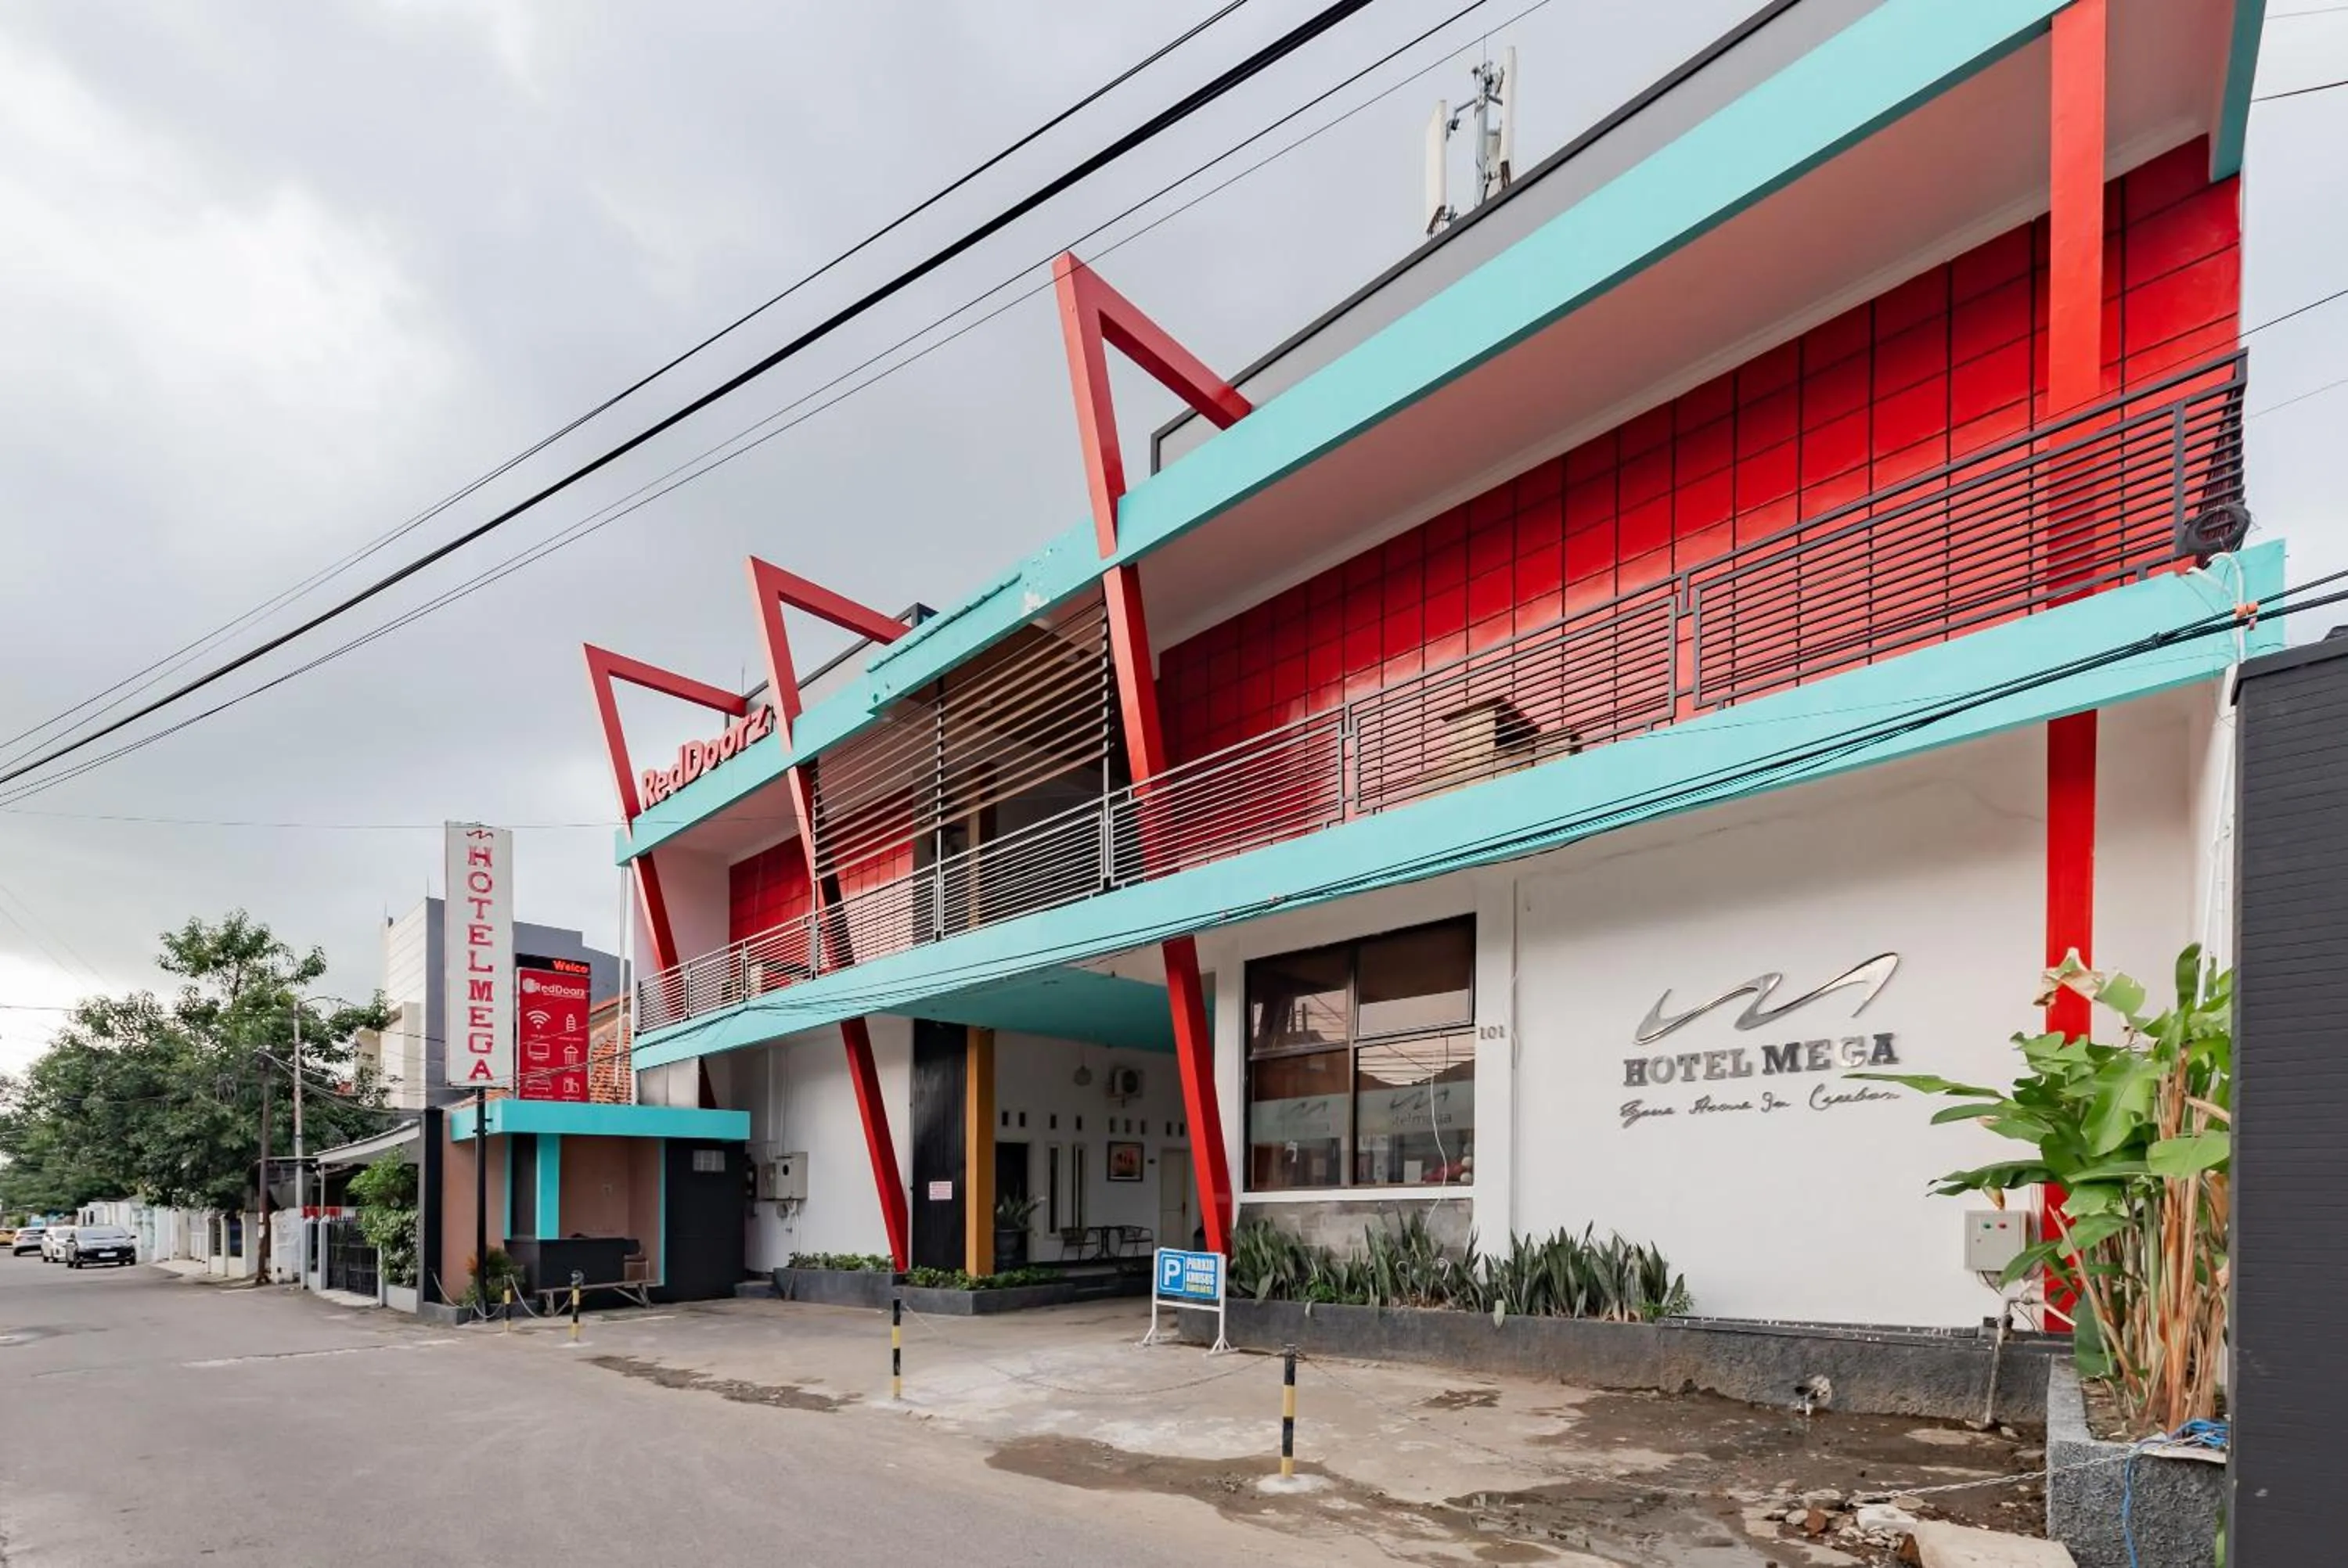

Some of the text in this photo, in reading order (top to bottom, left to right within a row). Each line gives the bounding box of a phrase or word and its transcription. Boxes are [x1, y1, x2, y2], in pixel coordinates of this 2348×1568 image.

[641, 703, 773, 811] RedDoorz
[467, 844, 494, 1081] HOTEL MEGA
[1479, 1025, 1504, 1040] 101
[1622, 1032, 1901, 1087] HOTEL MEGA
[1163, 1258, 1181, 1286] P
